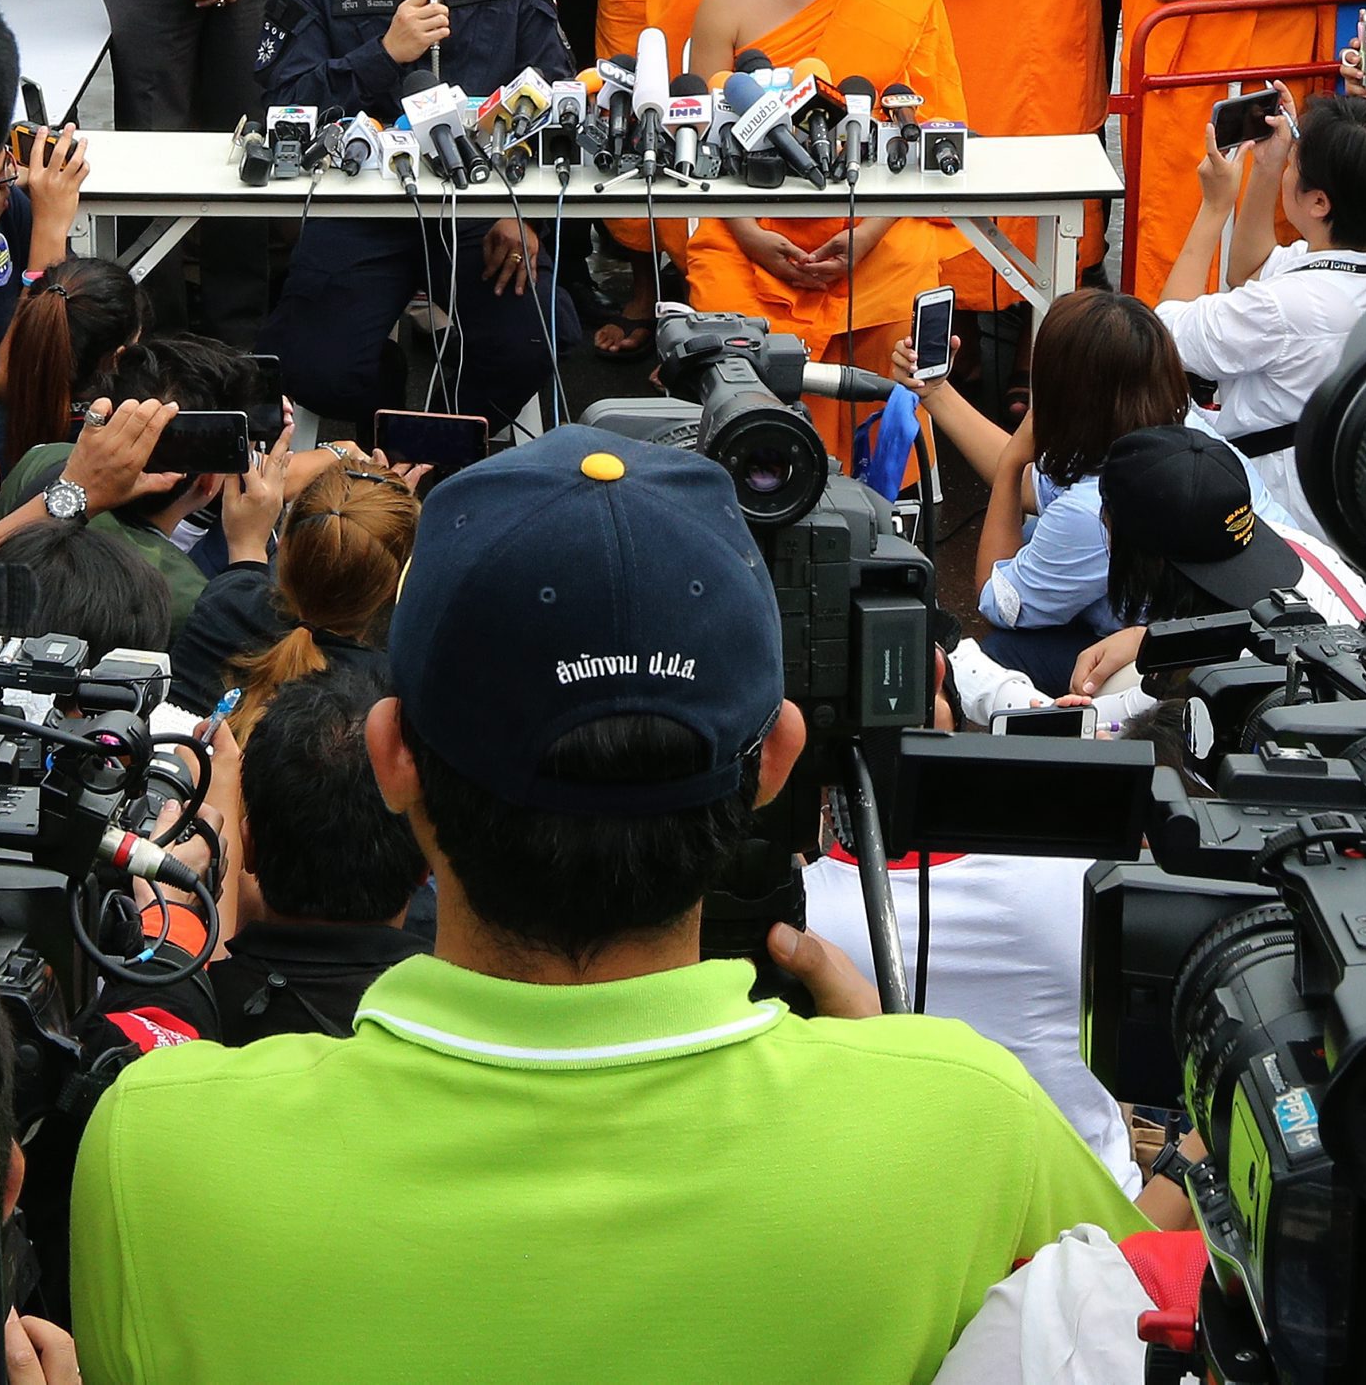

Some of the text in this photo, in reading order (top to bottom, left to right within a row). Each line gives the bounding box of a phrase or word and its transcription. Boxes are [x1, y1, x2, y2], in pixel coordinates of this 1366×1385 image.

[264, 21, 287, 41] SOU
[669, 107, 703, 118] INN
[1308, 260, 1357, 273] DOW JONES
[556, 651, 696, 685] สำนักงาน ป.ป.ส.
[1262, 1052, 1285, 1094] Panasonic
[1274, 1087, 1319, 1134] PPTV
[1295, 1131, 1319, 1149] HD
